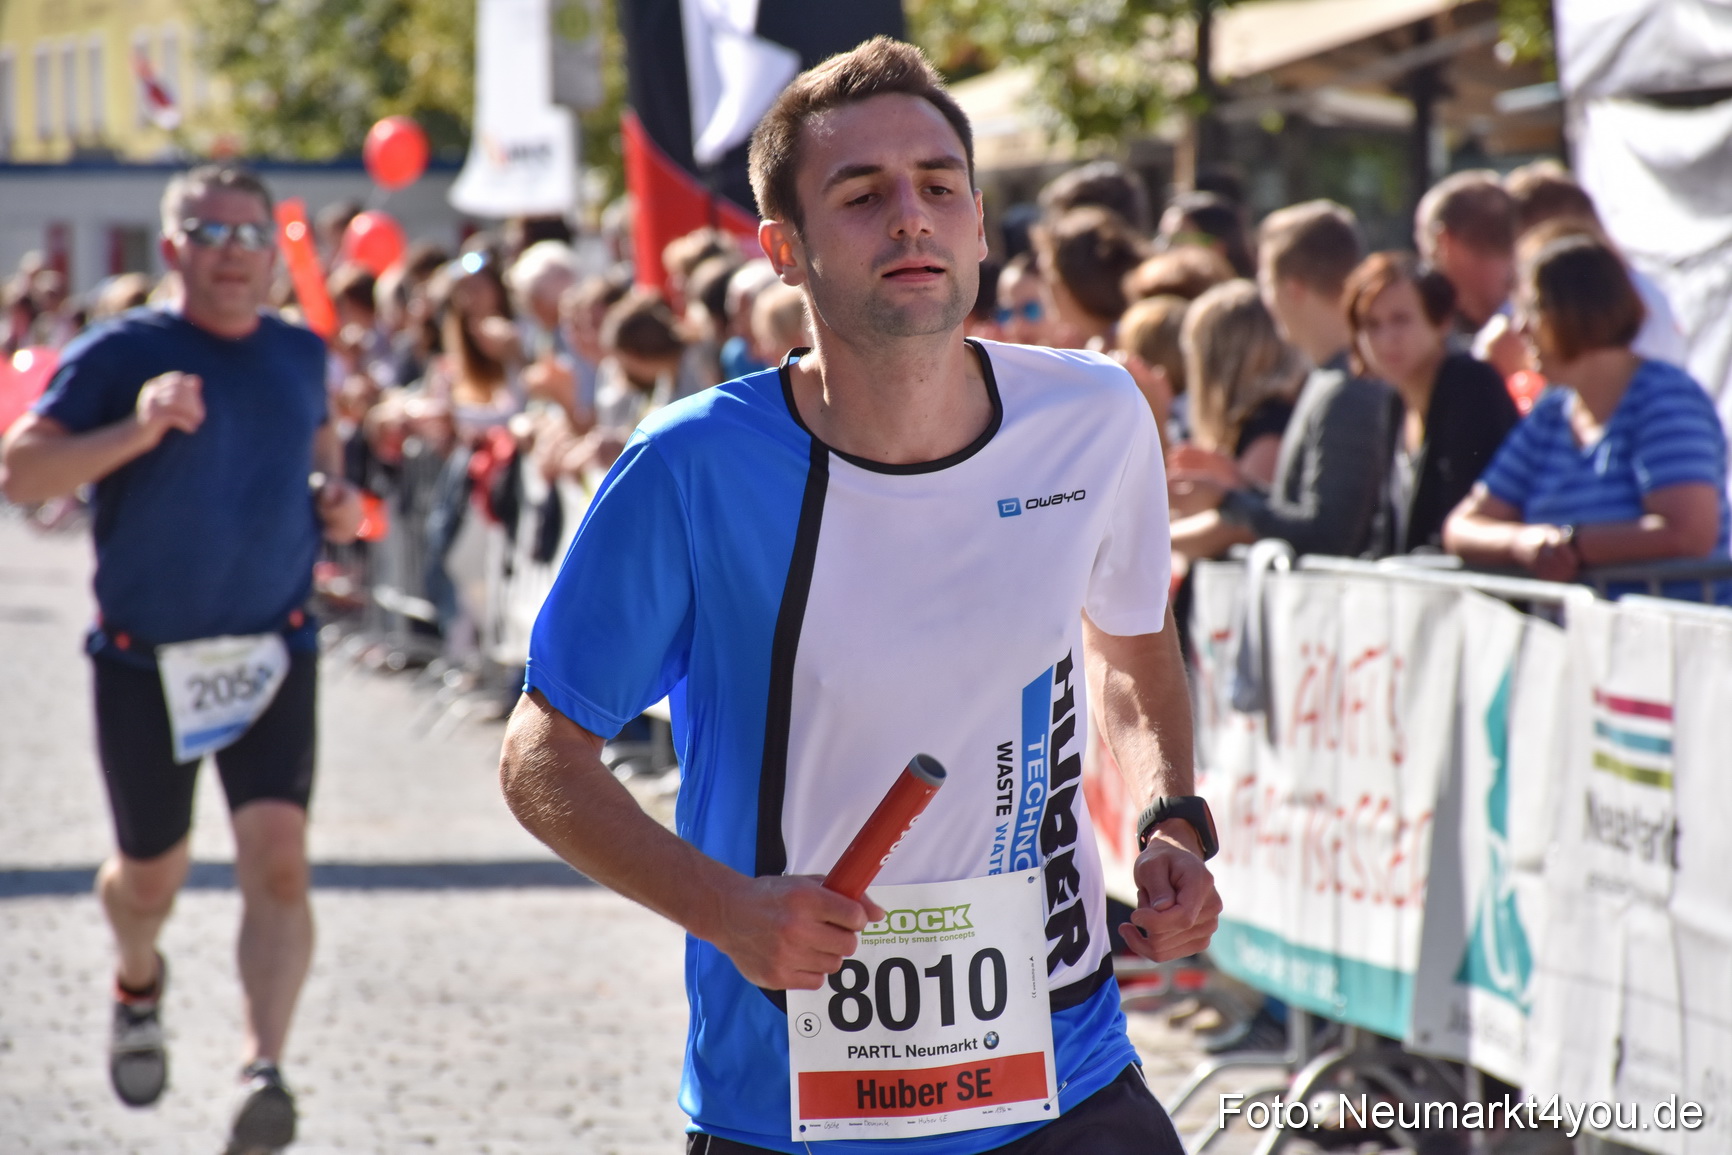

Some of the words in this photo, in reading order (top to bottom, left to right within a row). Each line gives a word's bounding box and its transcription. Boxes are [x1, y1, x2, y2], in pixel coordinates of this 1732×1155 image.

[996, 740, 1013, 817] WASTE
[1040, 646, 1090, 978] HUBER
[861, 904, 974, 936] BOCK
[861, 935, 896, 946] inspired
[899, 935, 909, 945] by
[912, 935, 937, 943] smart
[939, 931, 976, 942] concepts
[828, 947, 1008, 1032] 8010
[803, 1018, 813, 1032] S
[847, 1045, 901, 1059] PARTL
[905, 1037, 978, 1058] Neumarkt
[856, 1078, 948, 1110] Huber
[956, 1067, 993, 1101] SE
